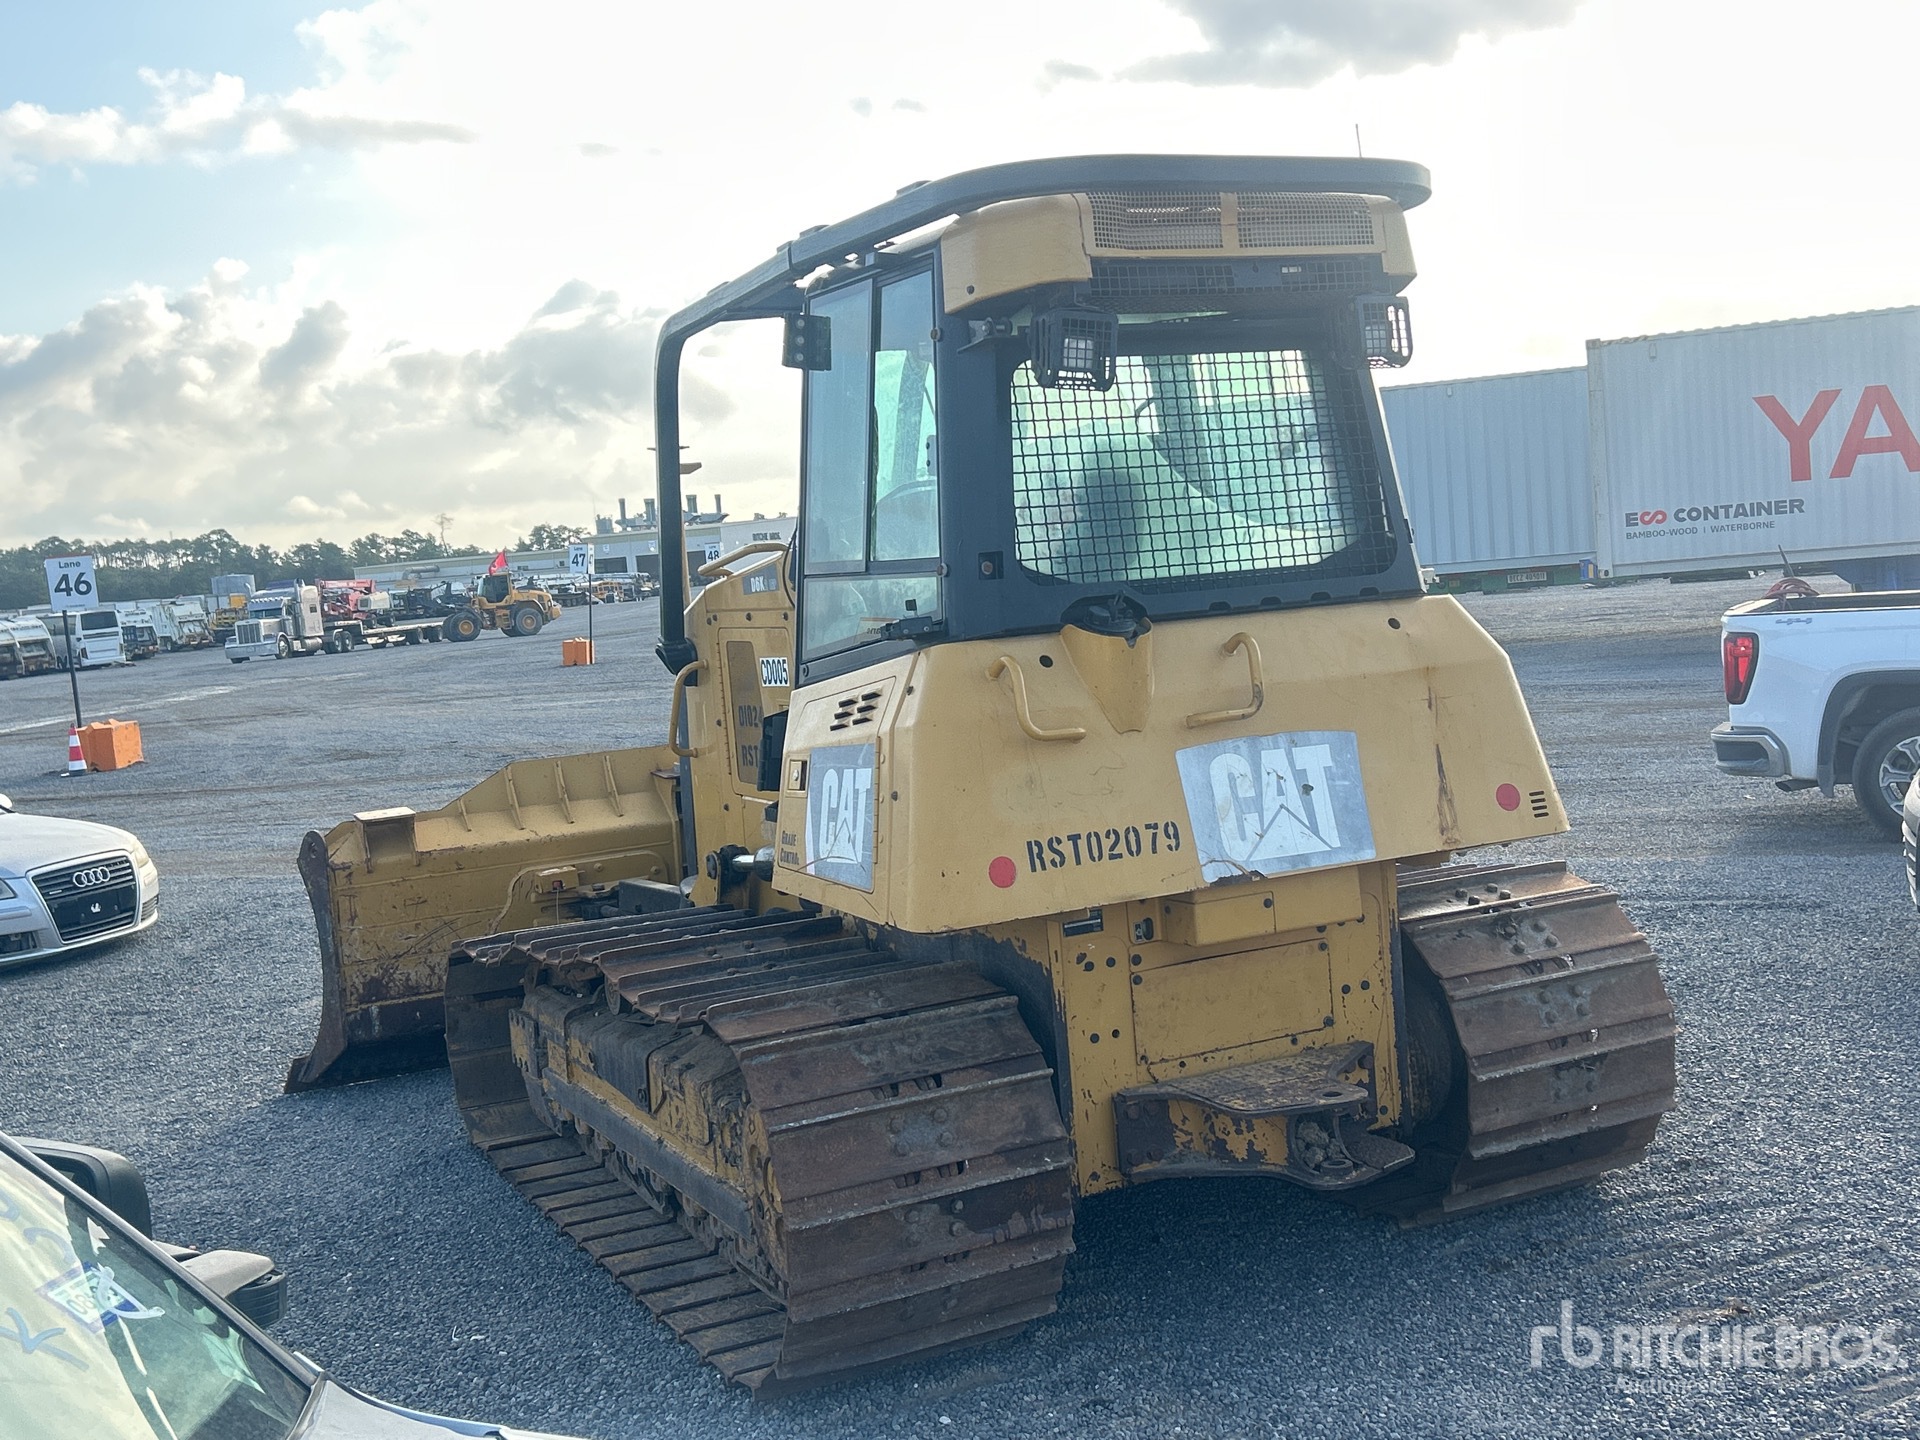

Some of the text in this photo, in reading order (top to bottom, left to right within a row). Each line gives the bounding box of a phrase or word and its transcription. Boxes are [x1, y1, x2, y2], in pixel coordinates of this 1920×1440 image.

[1752, 384, 1920, 482] YA
[1673, 499, 1805, 523] CONTAINER
[1626, 520, 1775, 540] BAMBOO-WOOD WATERBORNE
[58, 561, 81, 569] Lane
[571, 553, 586, 567] 47
[707, 550, 720, 561] 48
[54, 572, 92, 597] 46
[760, 659, 789, 686] CD005
[1209, 744, 1341, 862] CAT
[819, 768, 872, 865] CAT
[1026, 821, 1181, 873] RST02079
